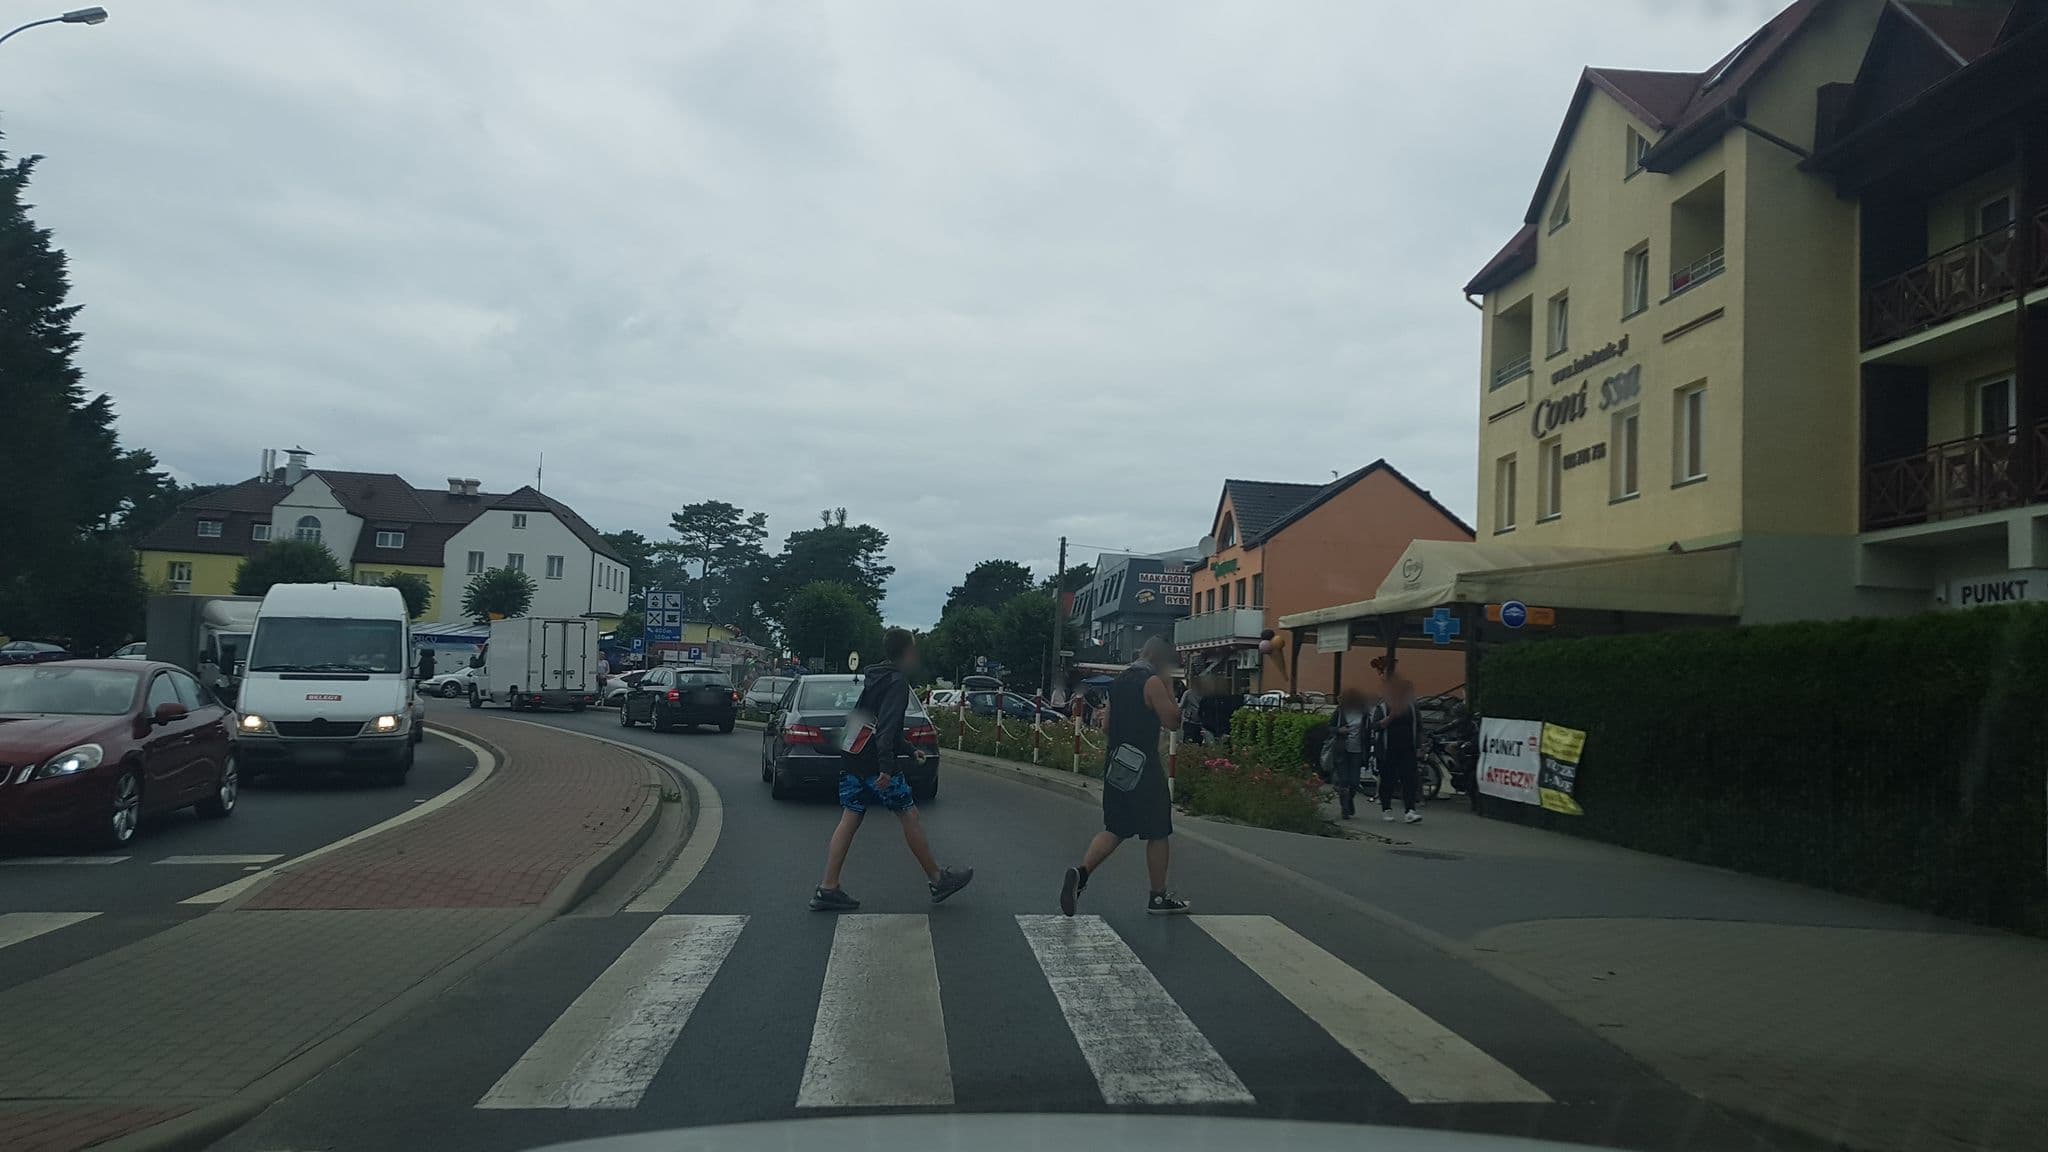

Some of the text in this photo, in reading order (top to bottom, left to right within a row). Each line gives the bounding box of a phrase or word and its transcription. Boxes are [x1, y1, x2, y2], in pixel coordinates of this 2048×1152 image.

[1140, 574, 1191, 584] MAKARONY
[1961, 579, 2029, 605] PUNKT
[634, 639, 641, 650] P
[690, 648, 699, 659] P
[1489, 738, 1524, 757] PUNKT
